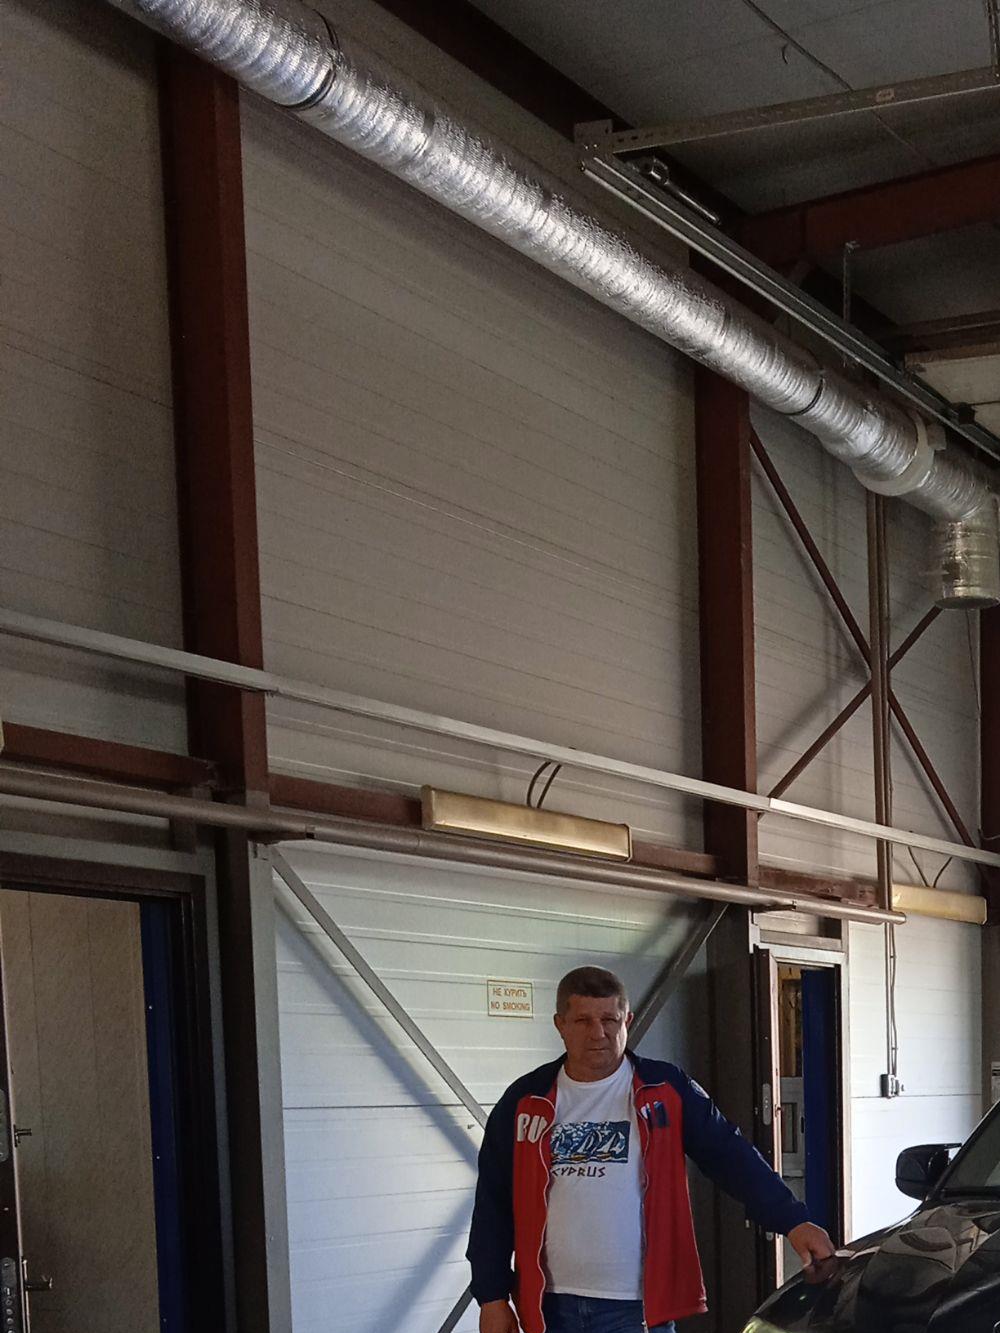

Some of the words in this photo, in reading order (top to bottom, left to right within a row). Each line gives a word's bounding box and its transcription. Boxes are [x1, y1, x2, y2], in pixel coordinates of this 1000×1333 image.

[492, 987, 502, 996] НЕ
[503, 988, 528, 998] КУРИТЬ
[490, 1000, 500, 1010] NO
[502, 1001, 530, 1011] SMOKING
[551, 1165, 606, 1178] CYPRUS
